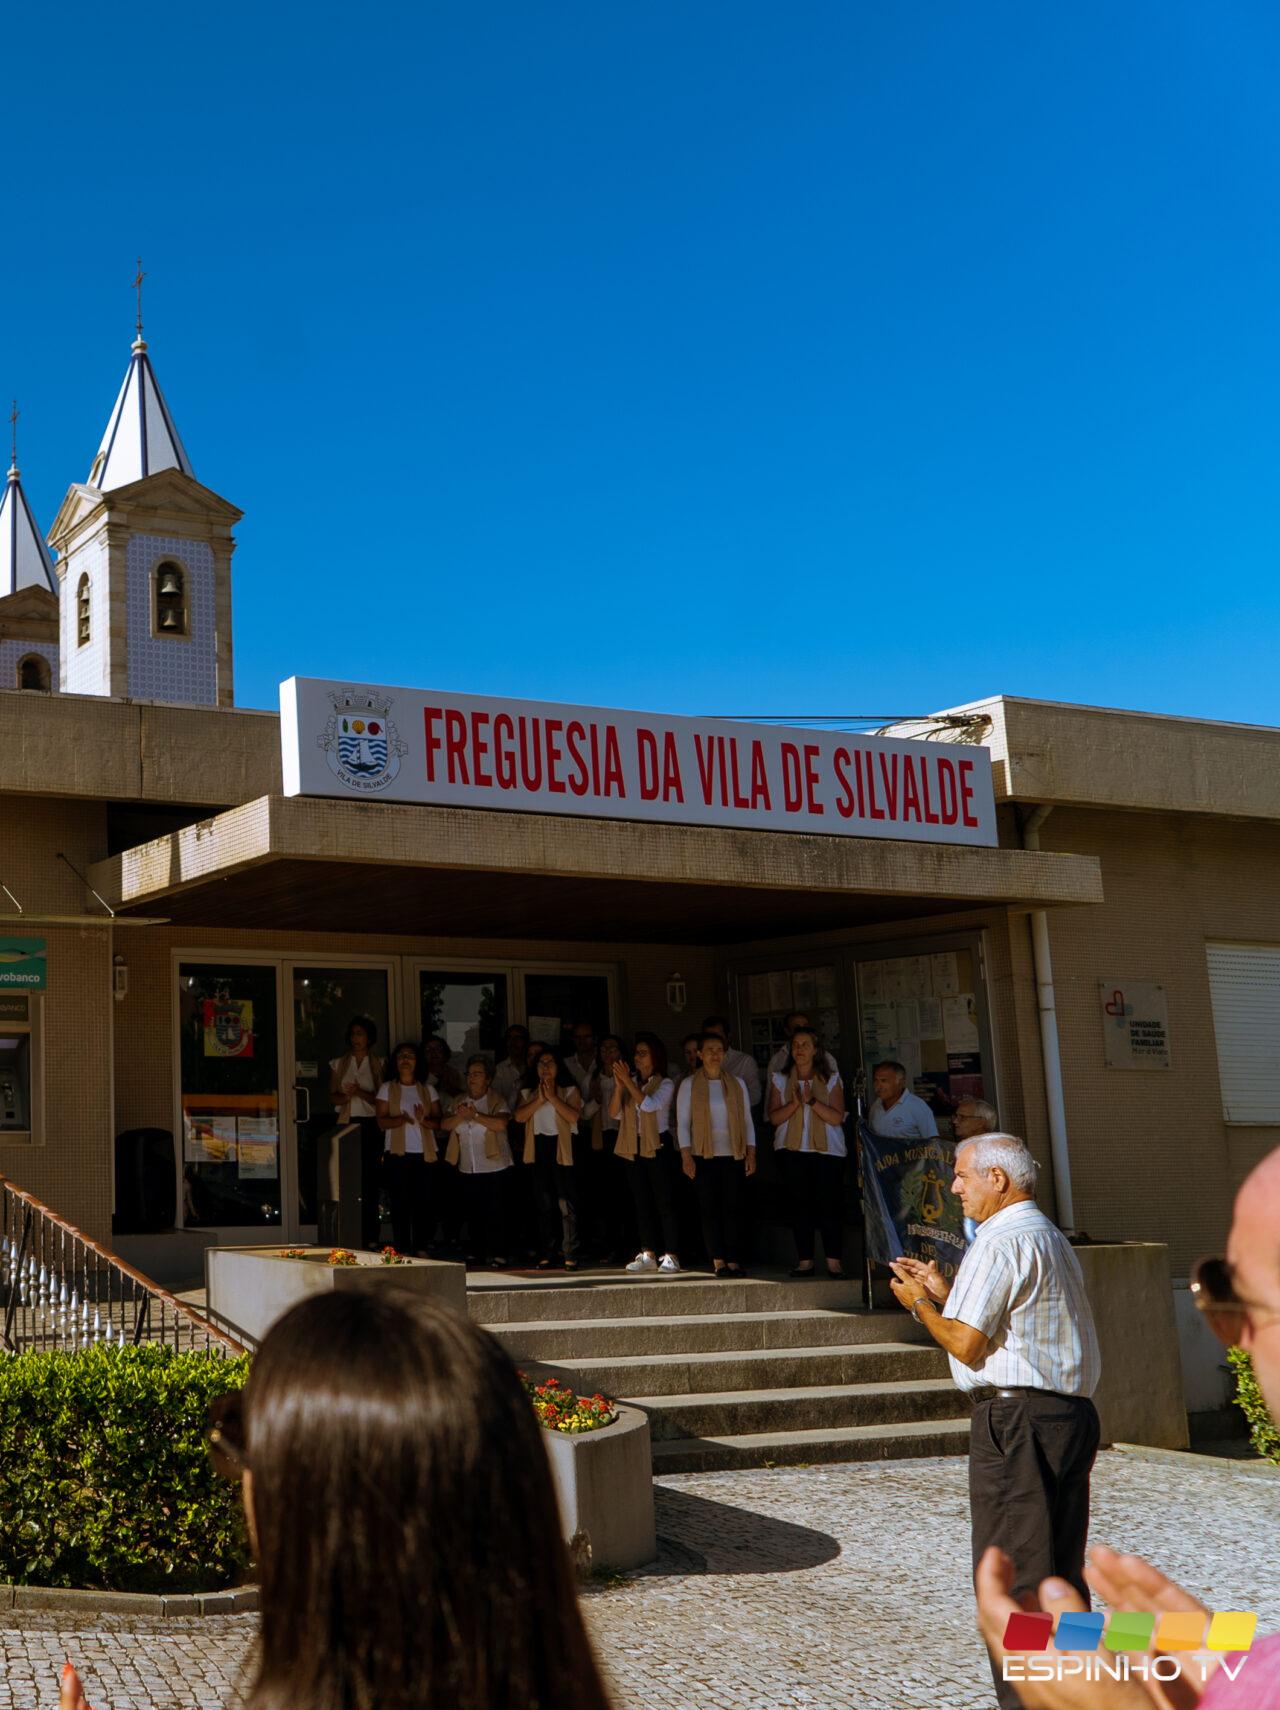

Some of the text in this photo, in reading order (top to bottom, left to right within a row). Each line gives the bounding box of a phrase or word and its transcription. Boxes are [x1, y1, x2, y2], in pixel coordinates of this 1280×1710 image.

[337, 769, 392, 789] VILA DE SILVALDE
[424, 706, 979, 828] FREGUESIA DA VILA DE SILVALDE
